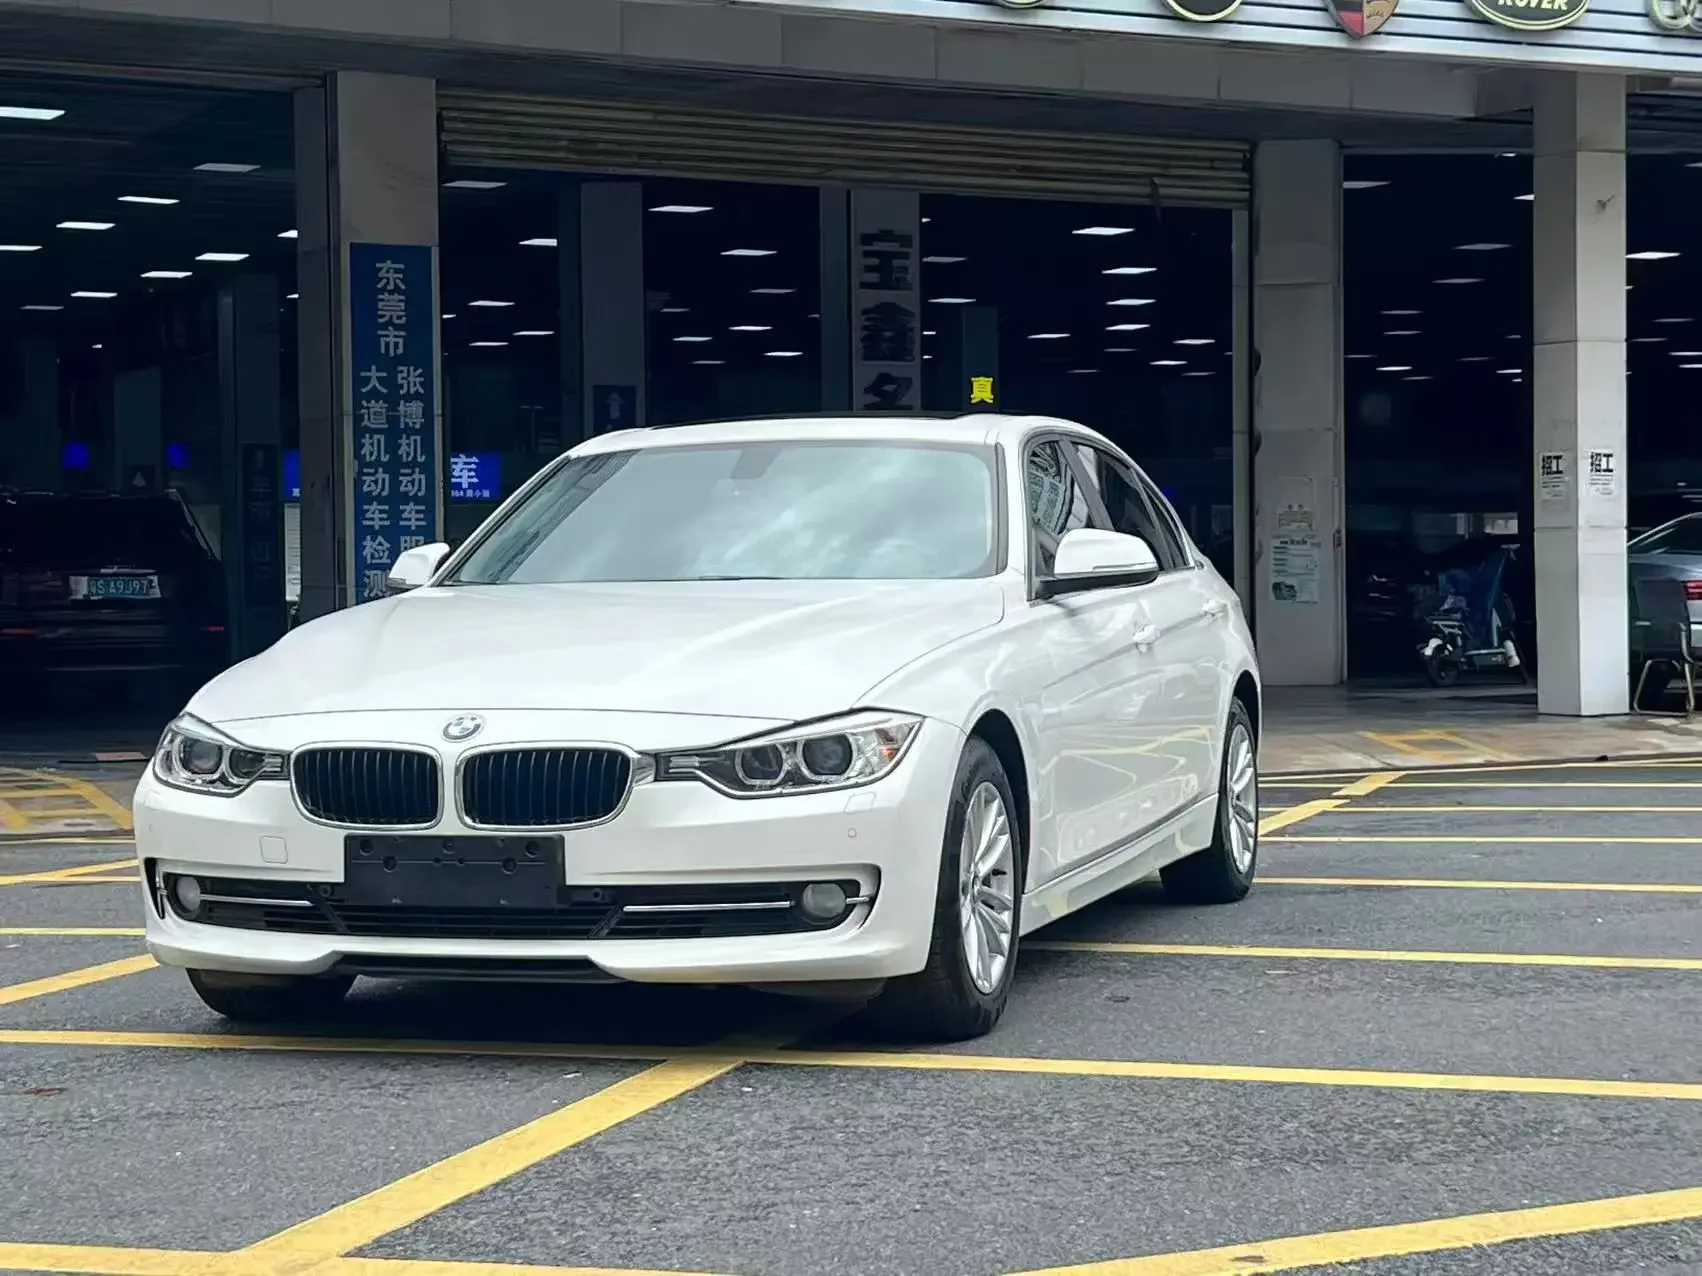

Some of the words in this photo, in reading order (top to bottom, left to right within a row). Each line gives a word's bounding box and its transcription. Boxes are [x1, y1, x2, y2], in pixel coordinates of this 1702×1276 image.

[375, 260, 407, 358] 东莞市
[450, 454, 479, 489] 车
[1541, 455, 1564, 476] 招工
[1590, 452, 1614, 473] 招工
